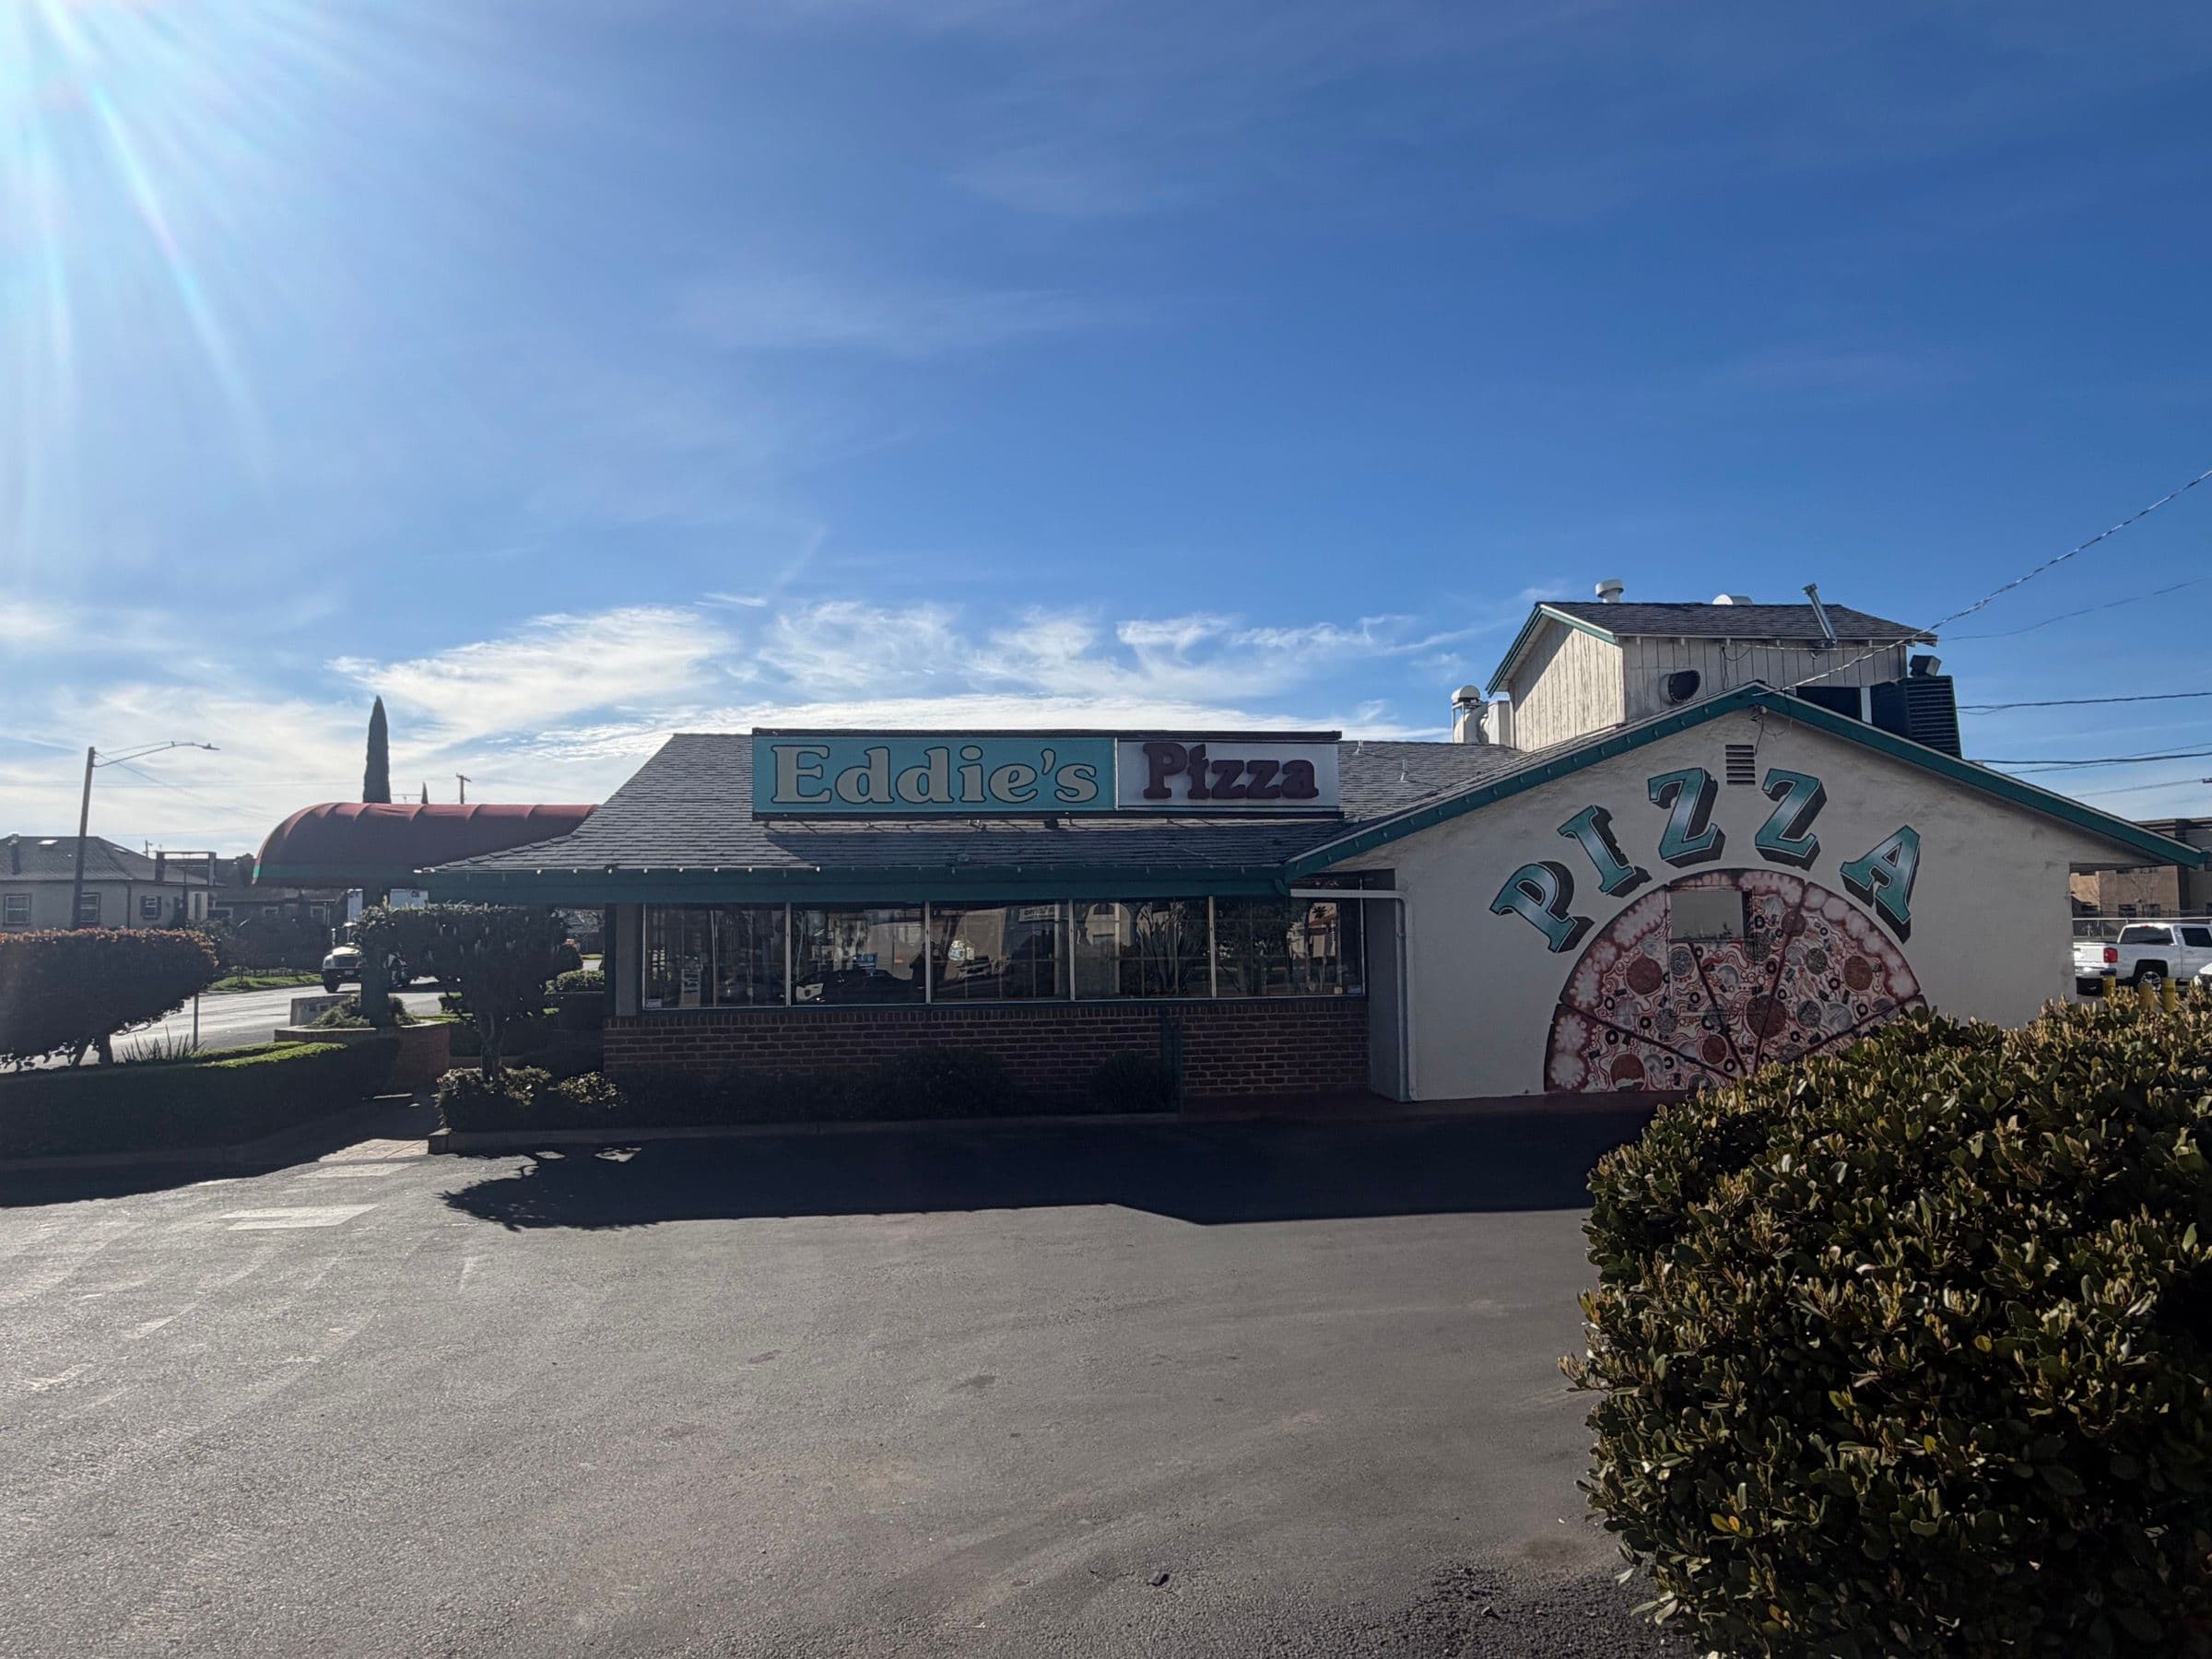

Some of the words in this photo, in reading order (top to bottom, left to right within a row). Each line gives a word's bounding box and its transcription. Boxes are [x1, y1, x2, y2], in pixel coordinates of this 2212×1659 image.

[771, 745, 1099, 805] Eddie's
[1142, 741, 1320, 800] Pizza
[1488, 767, 1922, 953] PIZZA
